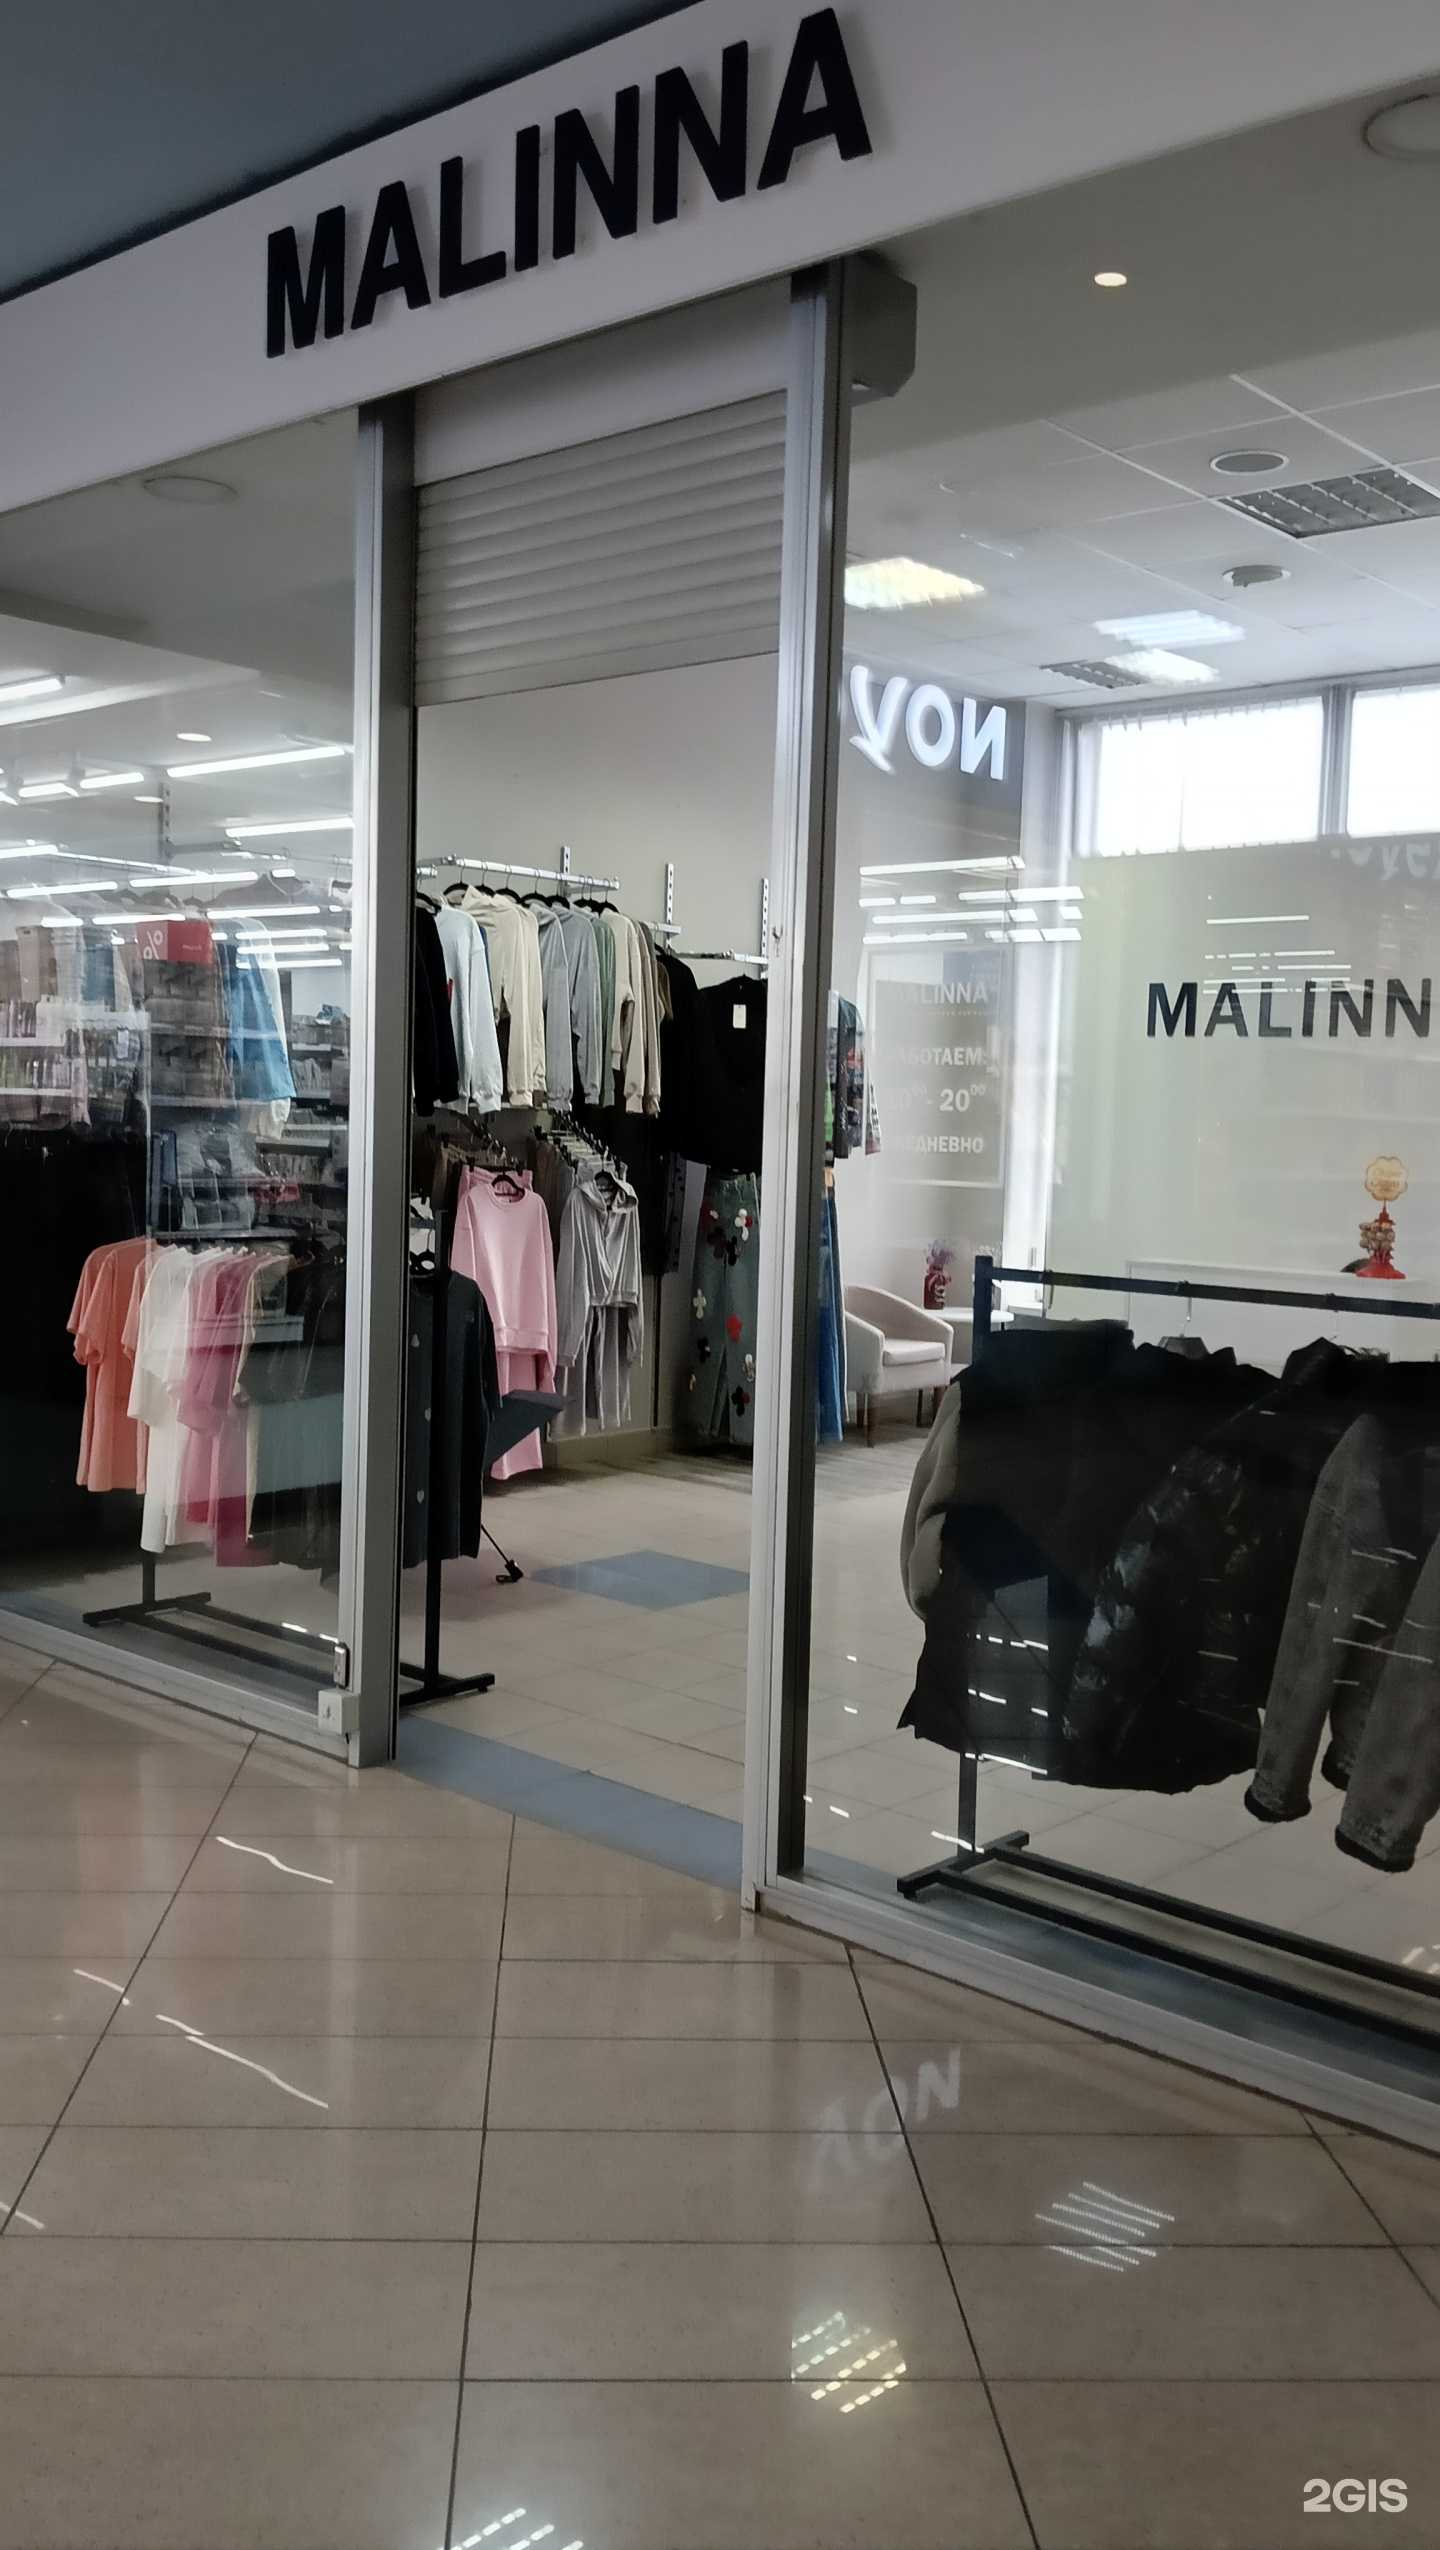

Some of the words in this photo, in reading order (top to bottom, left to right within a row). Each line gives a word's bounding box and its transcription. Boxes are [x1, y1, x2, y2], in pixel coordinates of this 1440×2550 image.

[267, 8, 873, 359] MALINNA
[890, 981, 990, 1005] ALINNA
[892, 1046, 988, 1067] АБОТАЕМ:
